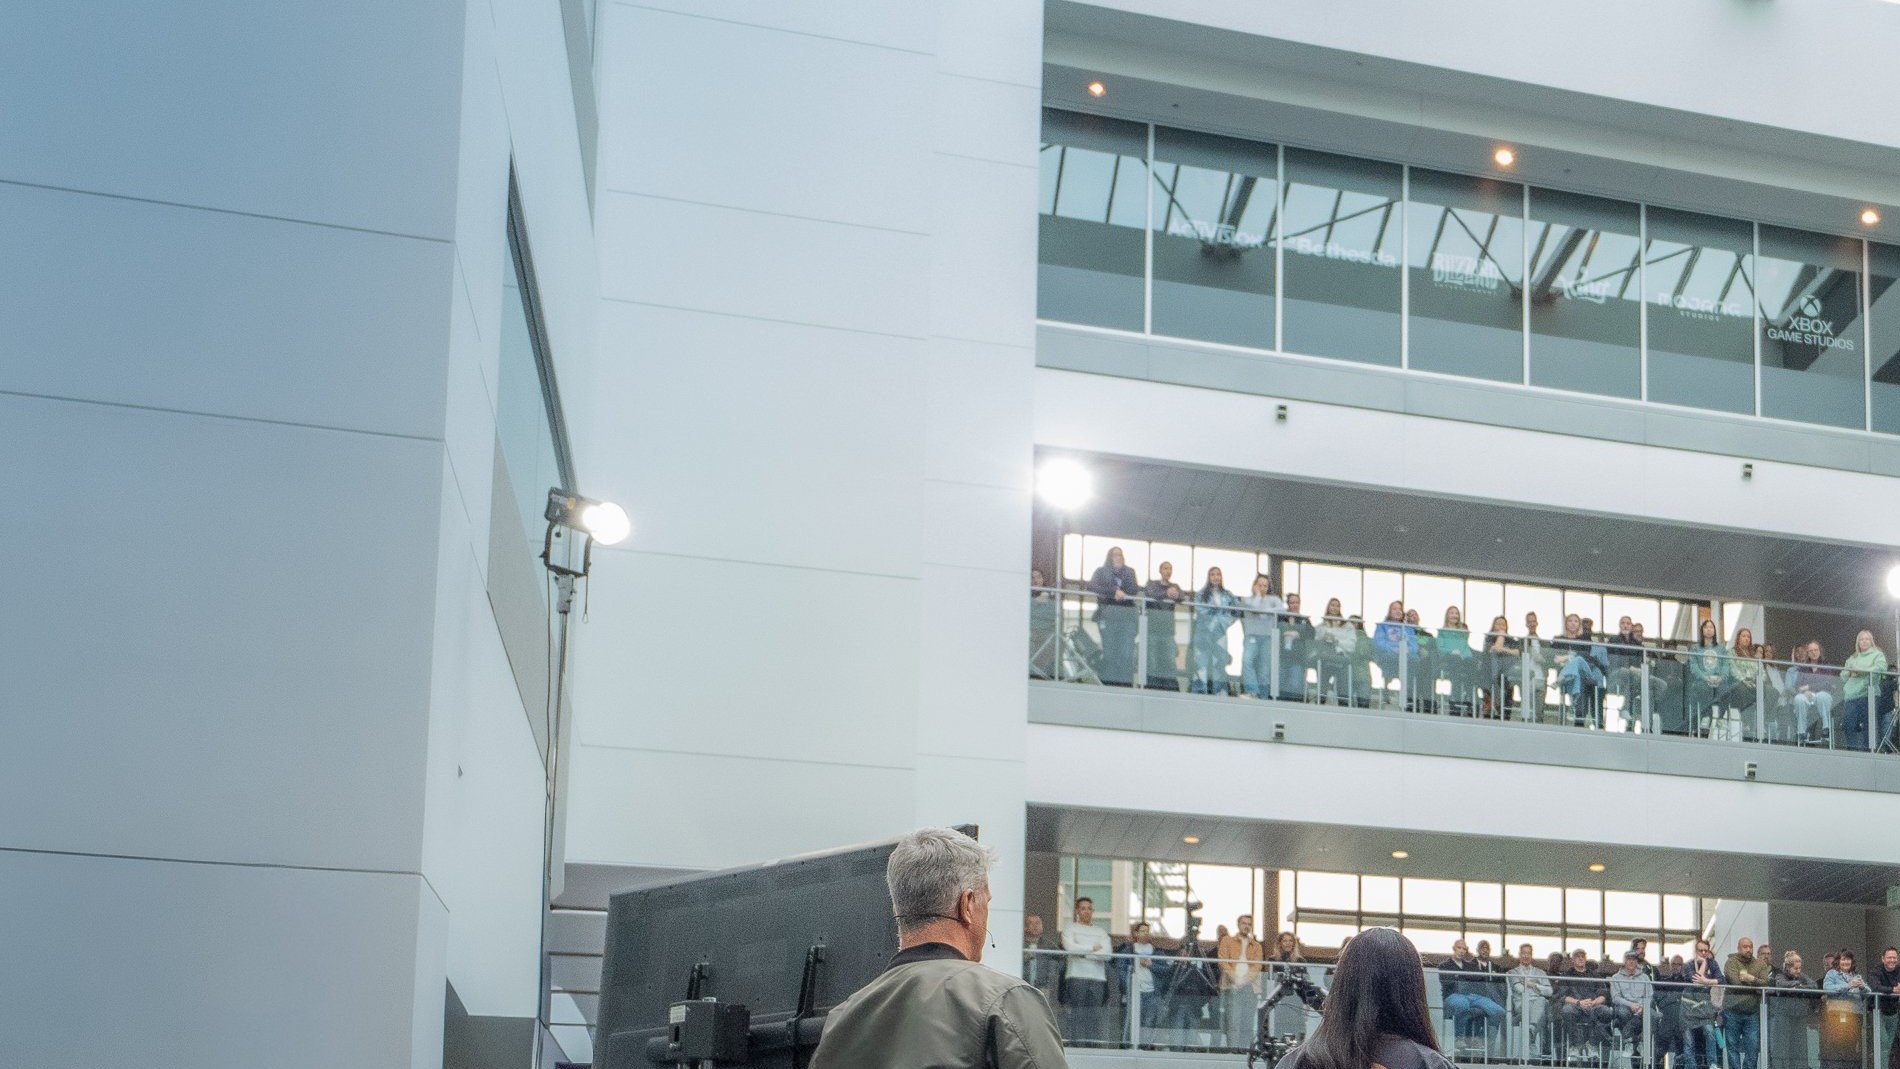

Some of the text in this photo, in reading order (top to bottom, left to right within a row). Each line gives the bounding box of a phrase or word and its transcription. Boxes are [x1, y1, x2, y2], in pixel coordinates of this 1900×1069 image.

[1788, 315, 1834, 336] XBOX
[1767, 328, 1855, 350] GAME STUDIOS
